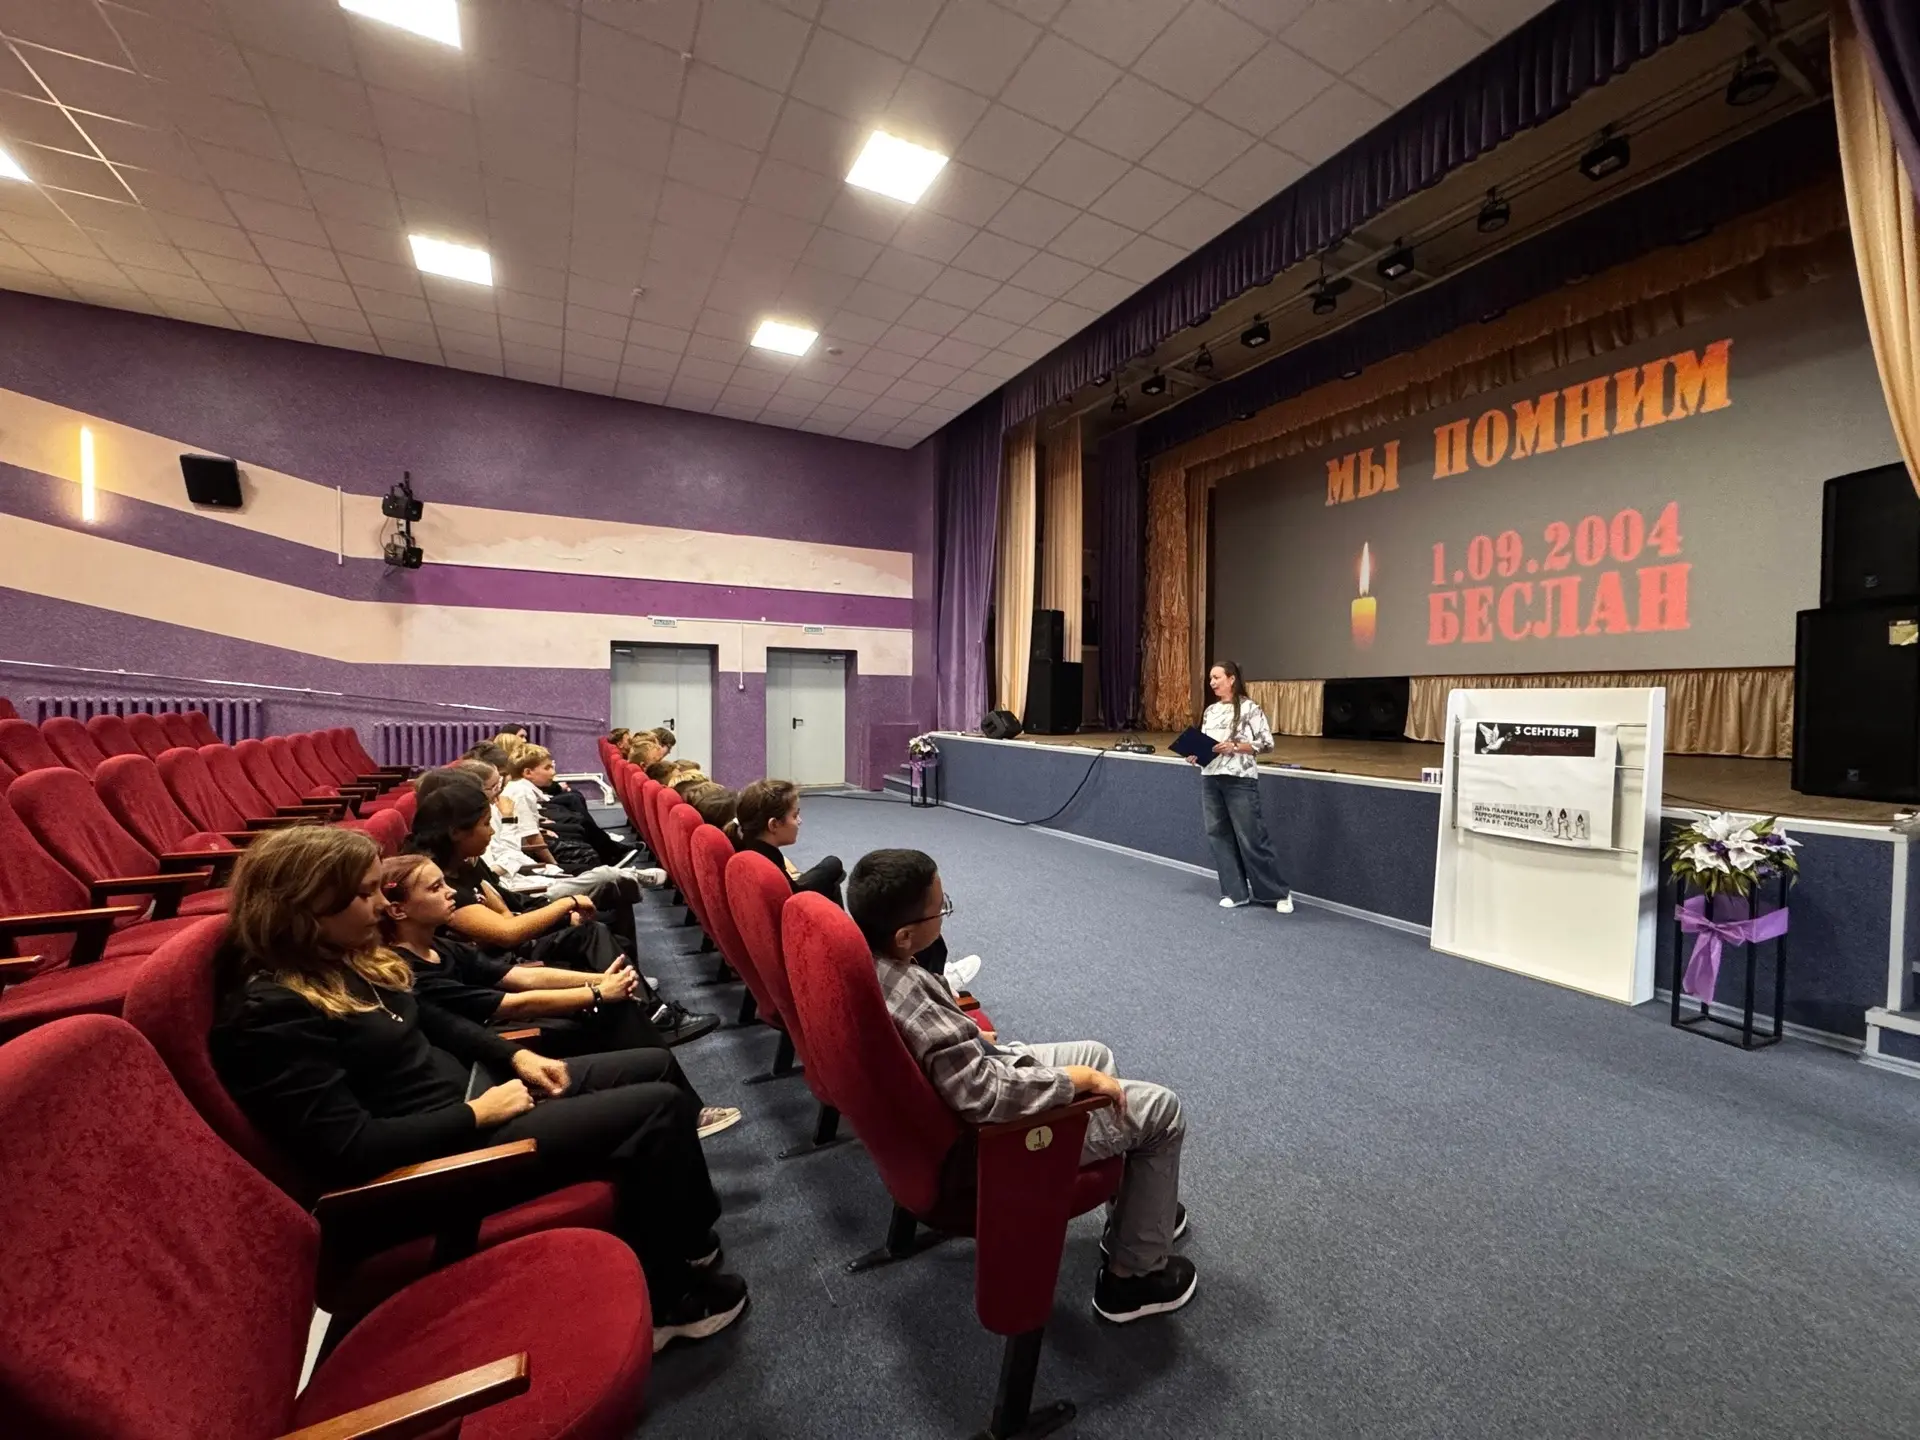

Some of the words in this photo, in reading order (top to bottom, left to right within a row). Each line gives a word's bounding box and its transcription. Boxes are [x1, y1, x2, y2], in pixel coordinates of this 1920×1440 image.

[1325, 440, 1400, 507] МЫ
[1433, 338, 1734, 480] ПОМНИМ
[1431, 500, 1684, 586] 1.09.2004
[1427, 563, 1692, 646] БЕСЛАН
[1514, 726, 1521, 735] 3
[1523, 726, 1579, 737] СЕНТЯБРЯ
[1475, 811, 1543, 826] ТЕРРОРИСТИЧЕСКОГО
[1492, 807, 1518, 816] ПАМЯТИ
[1519, 811, 1540, 819] ЖЕРТВ
[1503, 821, 1529, 830] БЕСЛАН
[1036, 1130, 1042, 1142] 1
